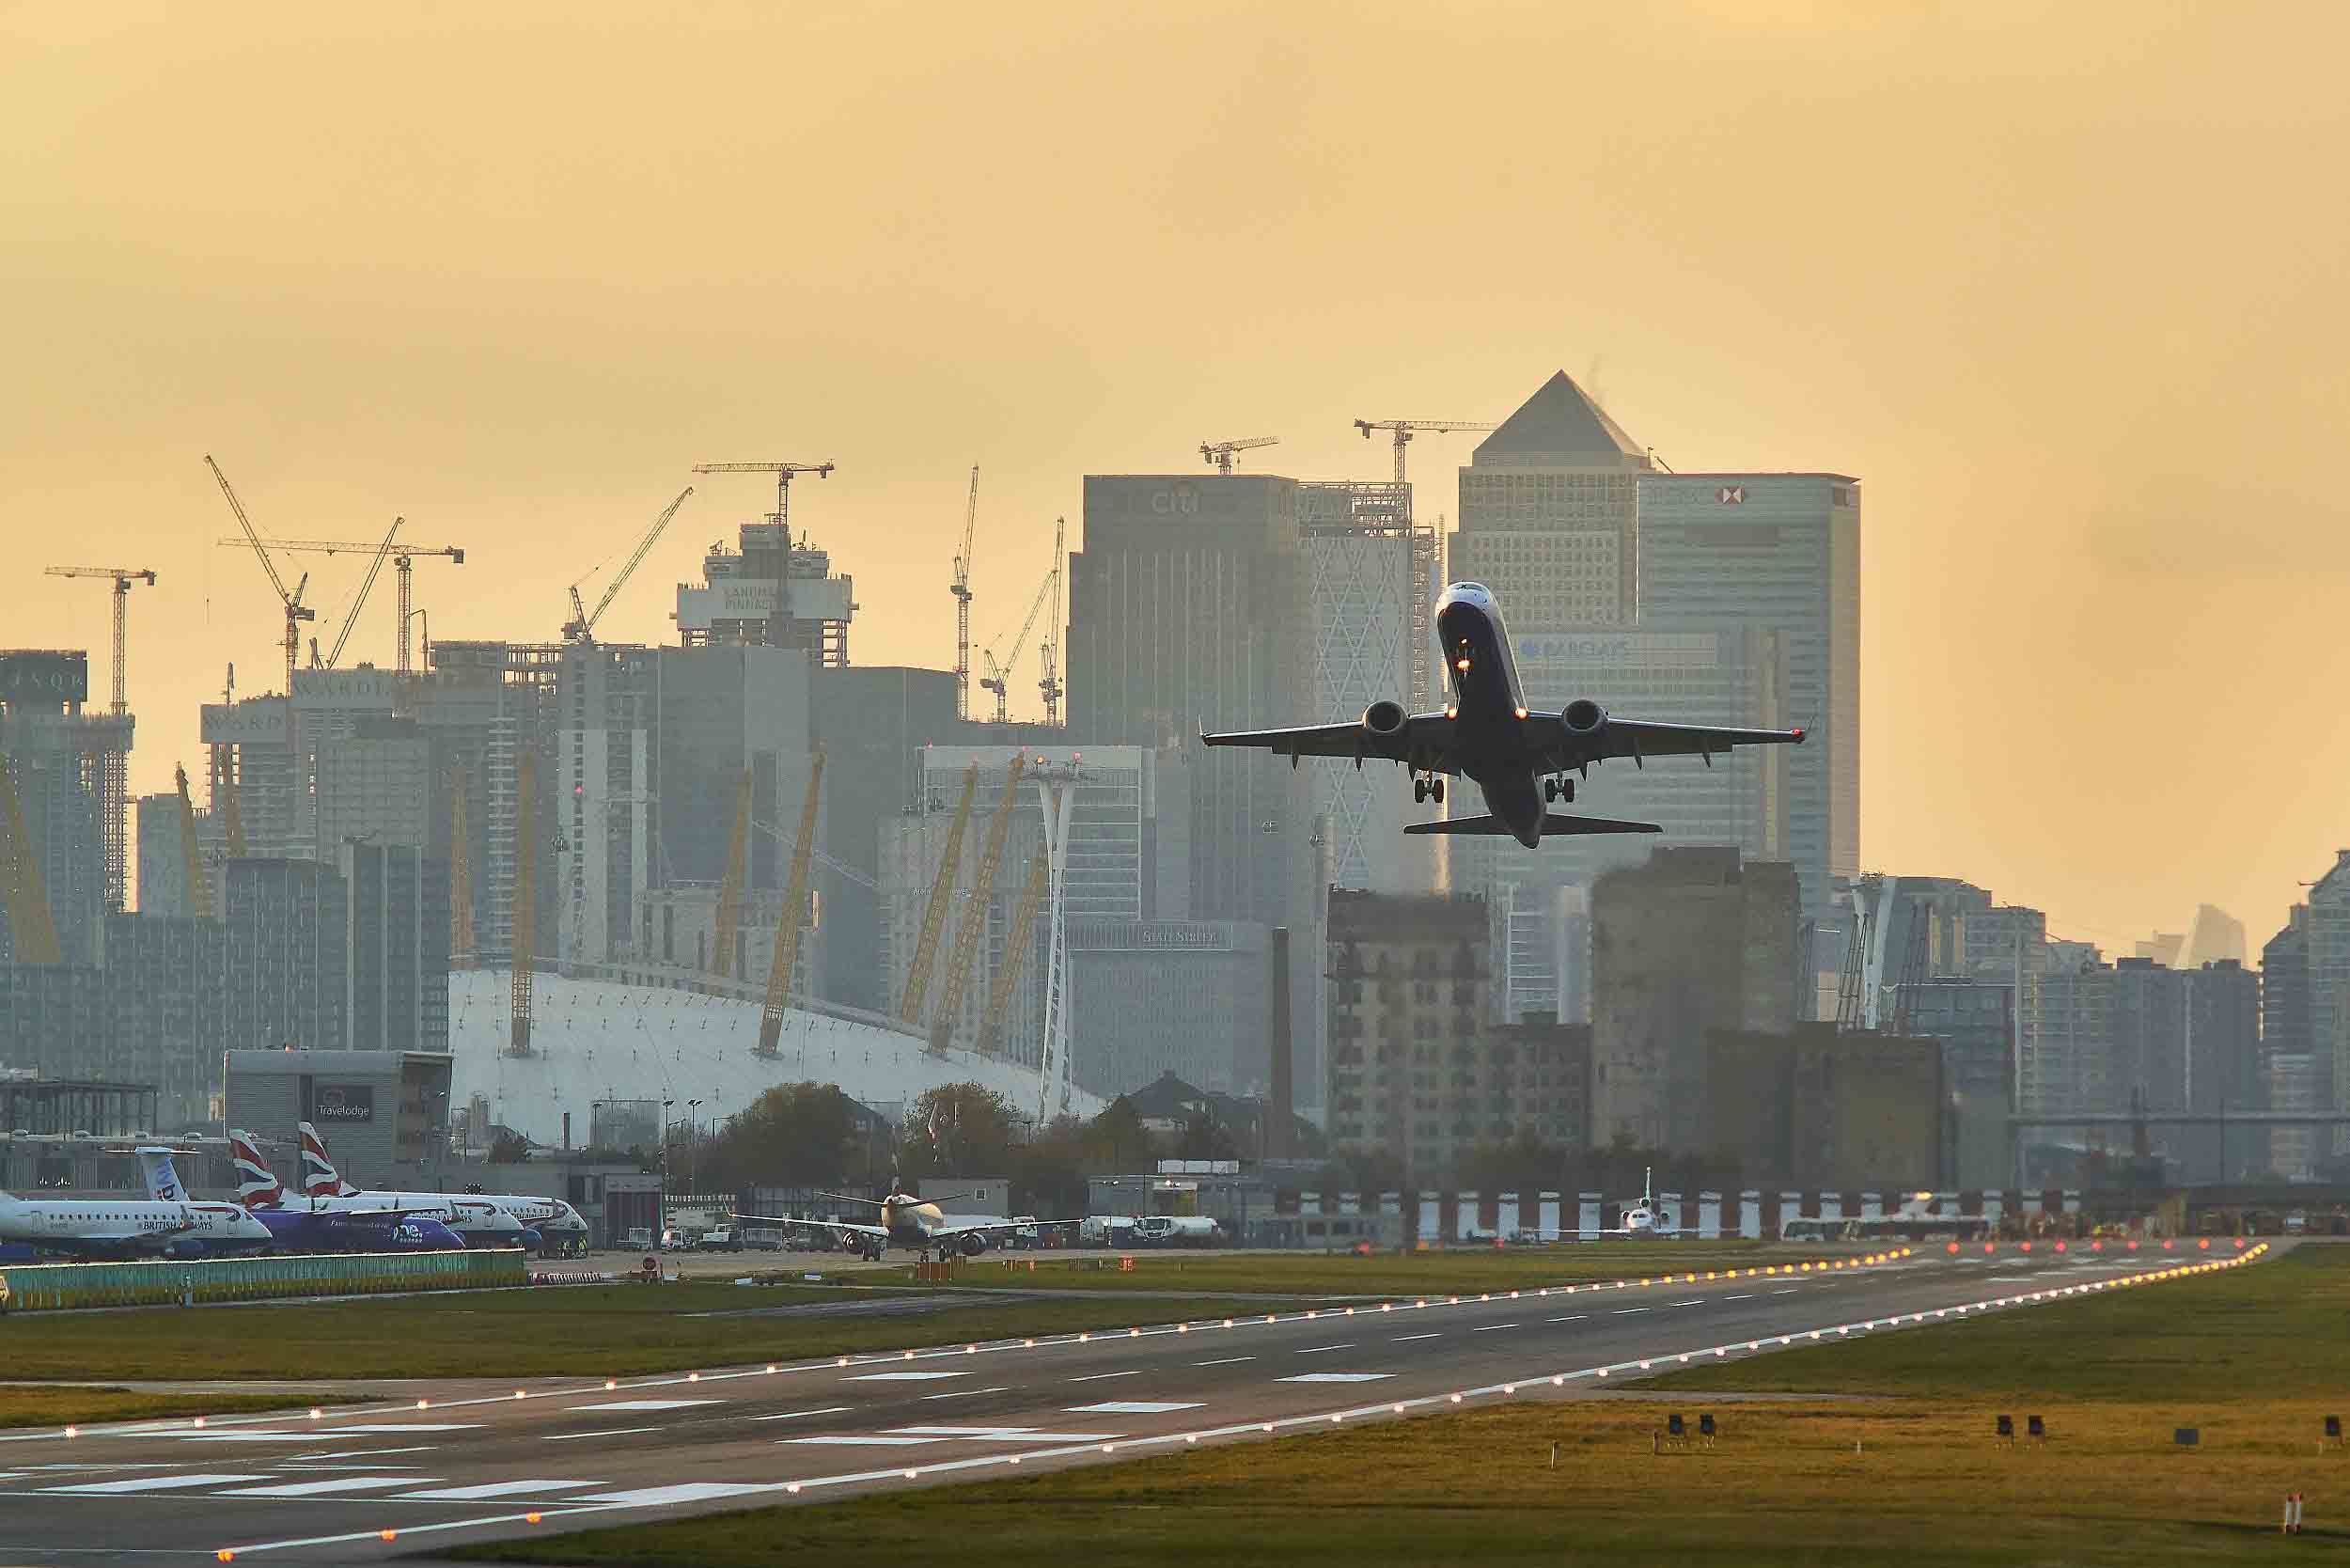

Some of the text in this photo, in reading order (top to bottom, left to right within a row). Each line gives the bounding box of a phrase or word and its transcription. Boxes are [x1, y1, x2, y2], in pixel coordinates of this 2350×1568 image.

[318, 1105, 369, 1118] Travelodge
[143, 1221, 213, 1231] BRITISH AAYS
